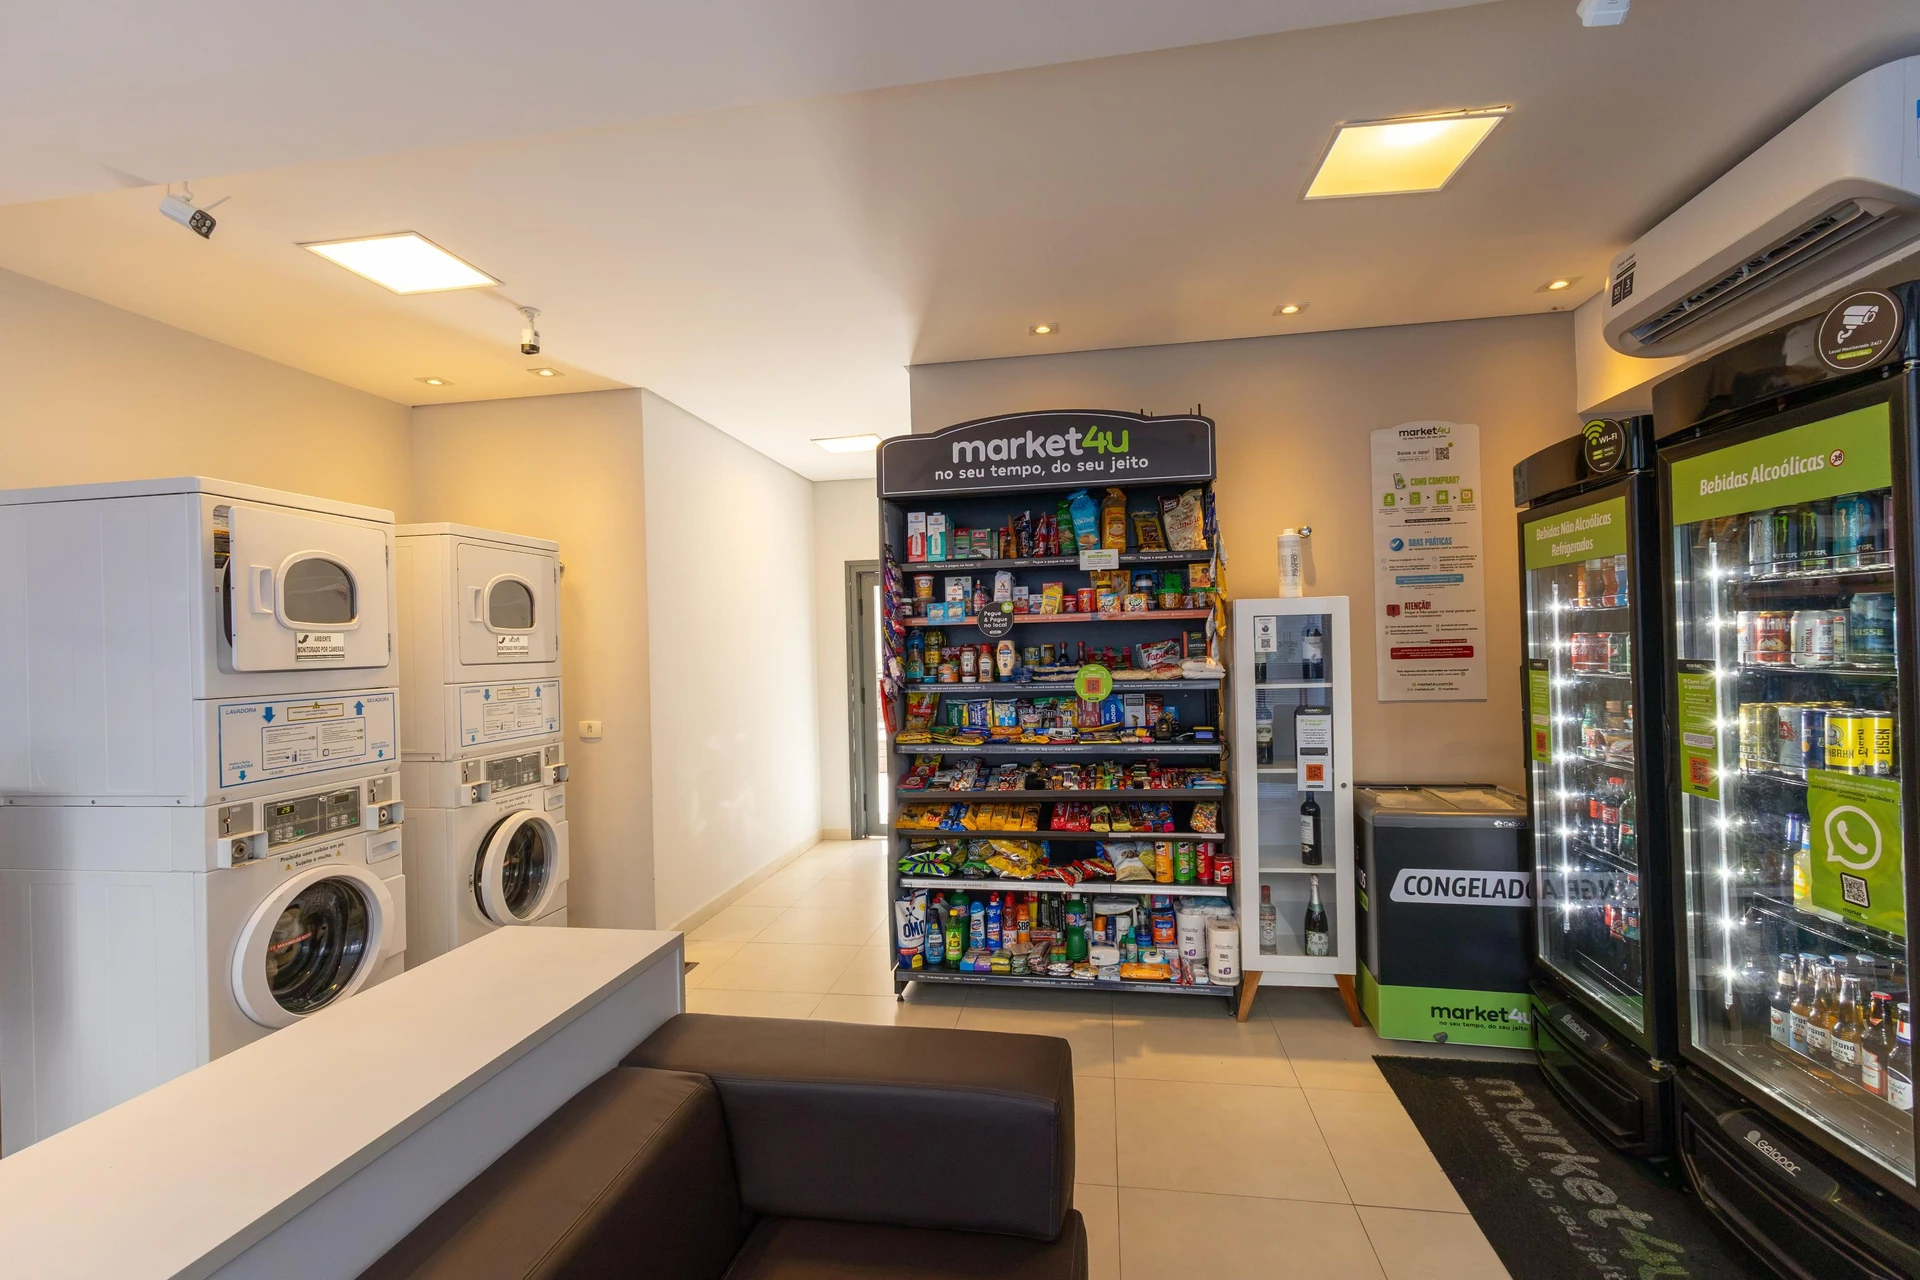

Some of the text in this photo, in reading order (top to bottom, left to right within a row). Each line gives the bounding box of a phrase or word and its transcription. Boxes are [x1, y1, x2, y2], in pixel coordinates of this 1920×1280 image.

[1399, 426, 1451, 437] market4u
[952, 426, 1129, 464] market4u
[935, 456, 1149, 480] no seu tempo, do seu jeito
[1700, 454, 1824, 496] Bebidas Alcoólicas
[1536, 512, 1612, 541] Bebidas Não Alcoólicas
[1551, 537, 1594, 558] Refrigerados
[280, 853, 301, 862] Proibido
[296, 858, 312, 866] Sujeito
[1018, 921, 1030, 930] SBP
[1430, 1005, 1531, 1025] market4u
[1463, 1021, 1486, 1030] tempo,
[1512, 1024, 1528, 1032] jeito
[1757, 1139, 1801, 1175] Gelopar
